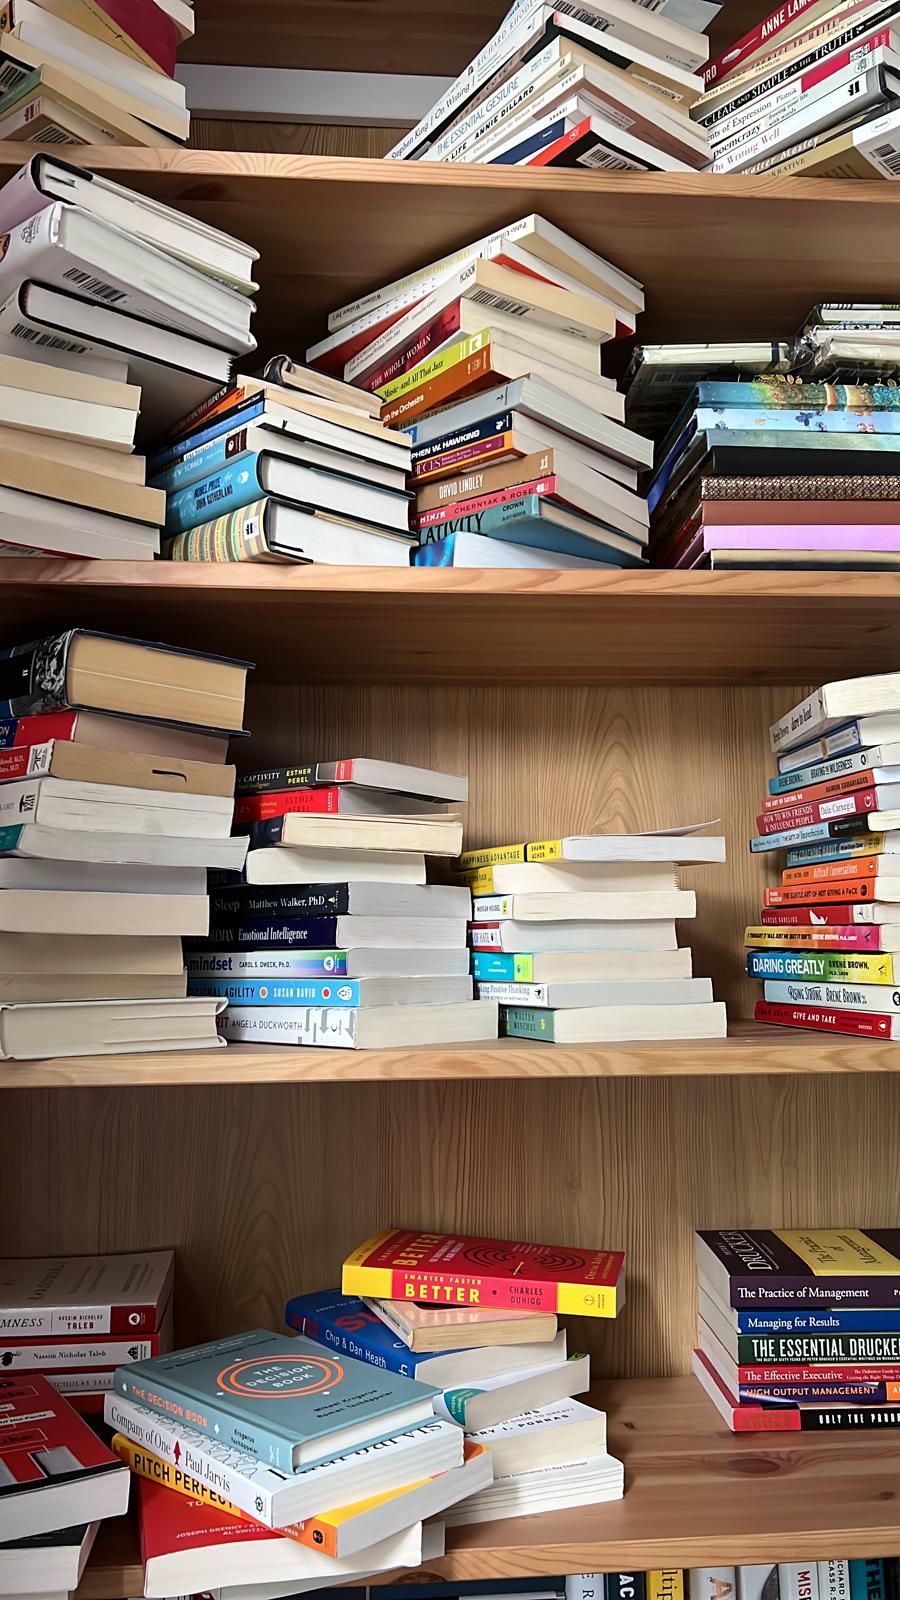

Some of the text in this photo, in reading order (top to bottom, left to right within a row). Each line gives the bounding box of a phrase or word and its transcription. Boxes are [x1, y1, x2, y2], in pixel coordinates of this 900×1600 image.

[761, 9, 785, 40] ANNE
[476, 30, 507, 68] RICHARD
[704, 102, 736, 127] CLEAR
[737, 95, 751, 106] AND
[750, 68, 790, 98] SIMPLE
[790, 64, 798, 72] AS
[812, 31, 855, 60] TRUTH
[391, 81, 473, 160] Stephen King On Writing
[436, 139, 451, 156] THE
[449, 111, 485, 144] ESSENTIAL
[485, 79, 522, 113] GESTURE
[450, 142, 468, 159] LIFE
[474, 115, 499, 140] ANNIE
[500, 85, 535, 118] DILLARD
[722, 123, 731, 133] of
[732, 101, 772, 127] Expression
[768, 115, 780, 127] with
[713, 123, 762, 159] poemcrazy
[711, 127, 781, 174] On Writing Well
[741, 135, 819, 176] Walter Mosley
[371, 333, 432, 390] THE WHOLE WOMAN
[383, 364, 431, 398] Music and All That
[391, 394, 424, 417] the Orchestra
[411, 429, 481, 460] PHEN W. HAWKING
[439, 474, 485, 500] DAVID LINDLEY
[420, 510, 446, 524] MINSK
[454, 496, 499, 514] CHERNYAK
[510, 488, 534, 500] ROSE
[502, 501, 525, 512] CROWN
[243, 770, 281, 784] CAPTIVITY
[286, 768, 312, 778] ESTHER
[287, 776, 309, 785] PEREL
[763, 805, 813, 824] HOW TO WIN FRIENDS
[820, 801, 855, 816] Dale Carnegie
[770, 815, 815, 833] INFLUENCE PEOPLE
[531, 844, 545, 852] SHAWN
[463, 850, 520, 864] HAPPINESS ADVANTAGE
[827, 888, 841, 897] GIVING
[841, 887, 847, 895] A
[214, 895, 326, 913] Sleep Matthew Walker, PhD
[238, 926, 308, 944] Emotional Intelligence
[188, 956, 233, 971] mindset
[239, 960, 253, 968] CAROL
[254, 960, 259, 968] S.
[259, 960, 278, 969] DWECK,
[752, 957, 870, 976] DARING GREATLY BRENÉ BROWN,
[224, 987, 256, 999] AGILITY
[273, 987, 294, 998] SUSAN
[508, 984, 531, 996] Thinking
[787, 985, 804, 1001] RISING
[804, 986, 822, 1001] STRONG
[842, 988, 862, 1004] BROWN
[513, 1011, 535, 1021] WALTER
[792, 1011, 806, 1021] GIVE
[807, 1012, 820, 1022] AND
[820, 1013, 836, 1024] TAKE
[231, 1019, 303, 1030] ANGELA DUCKWORTH
[513, 1022, 537, 1033] MISCHEL
[404, 1273, 482, 1286] SMARTER FASTER
[404, 1282, 480, 1303] BETTER
[509, 1285, 543, 1296] CHARLES
[737, 1286, 870, 1301] The Practice of Management
[510, 1296, 541, 1306] DUHIGG
[66, 1321, 95, 1331] TALEB
[747, 1316, 841, 1330] Managing for Results
[33, 1352, 57, 1360] Nassim
[58, 1350, 87, 1359] Nicholas
[325, 1329, 388, 1370] Chip & Dan Heath
[752, 1339, 775, 1358] THE
[779, 1338, 846, 1358] ESSENTIAL
[245, 1363, 315, 1387] DECISION
[253, 1365, 283, 1376] THE
[744, 1370, 843, 1381] The Effective Executive
[272, 1373, 315, 1388] BOOK
[745, 1385, 877, 1398] HIGH OUTPUT MANAGEMENT
[131, 1385, 209, 1429] THE DECISION BOOK
[517, 1414, 570, 1427] PORRAS
[818, 1413, 864, 1425] ONLY THE
[233, 1428, 255, 1444] Krogerus
[111, 1406, 232, 1493] Company of One Paul Jarvis
[133, 1452, 172, 1483] PITCH
[175, 1524, 243, 1539] JOSEPH GRENNY
